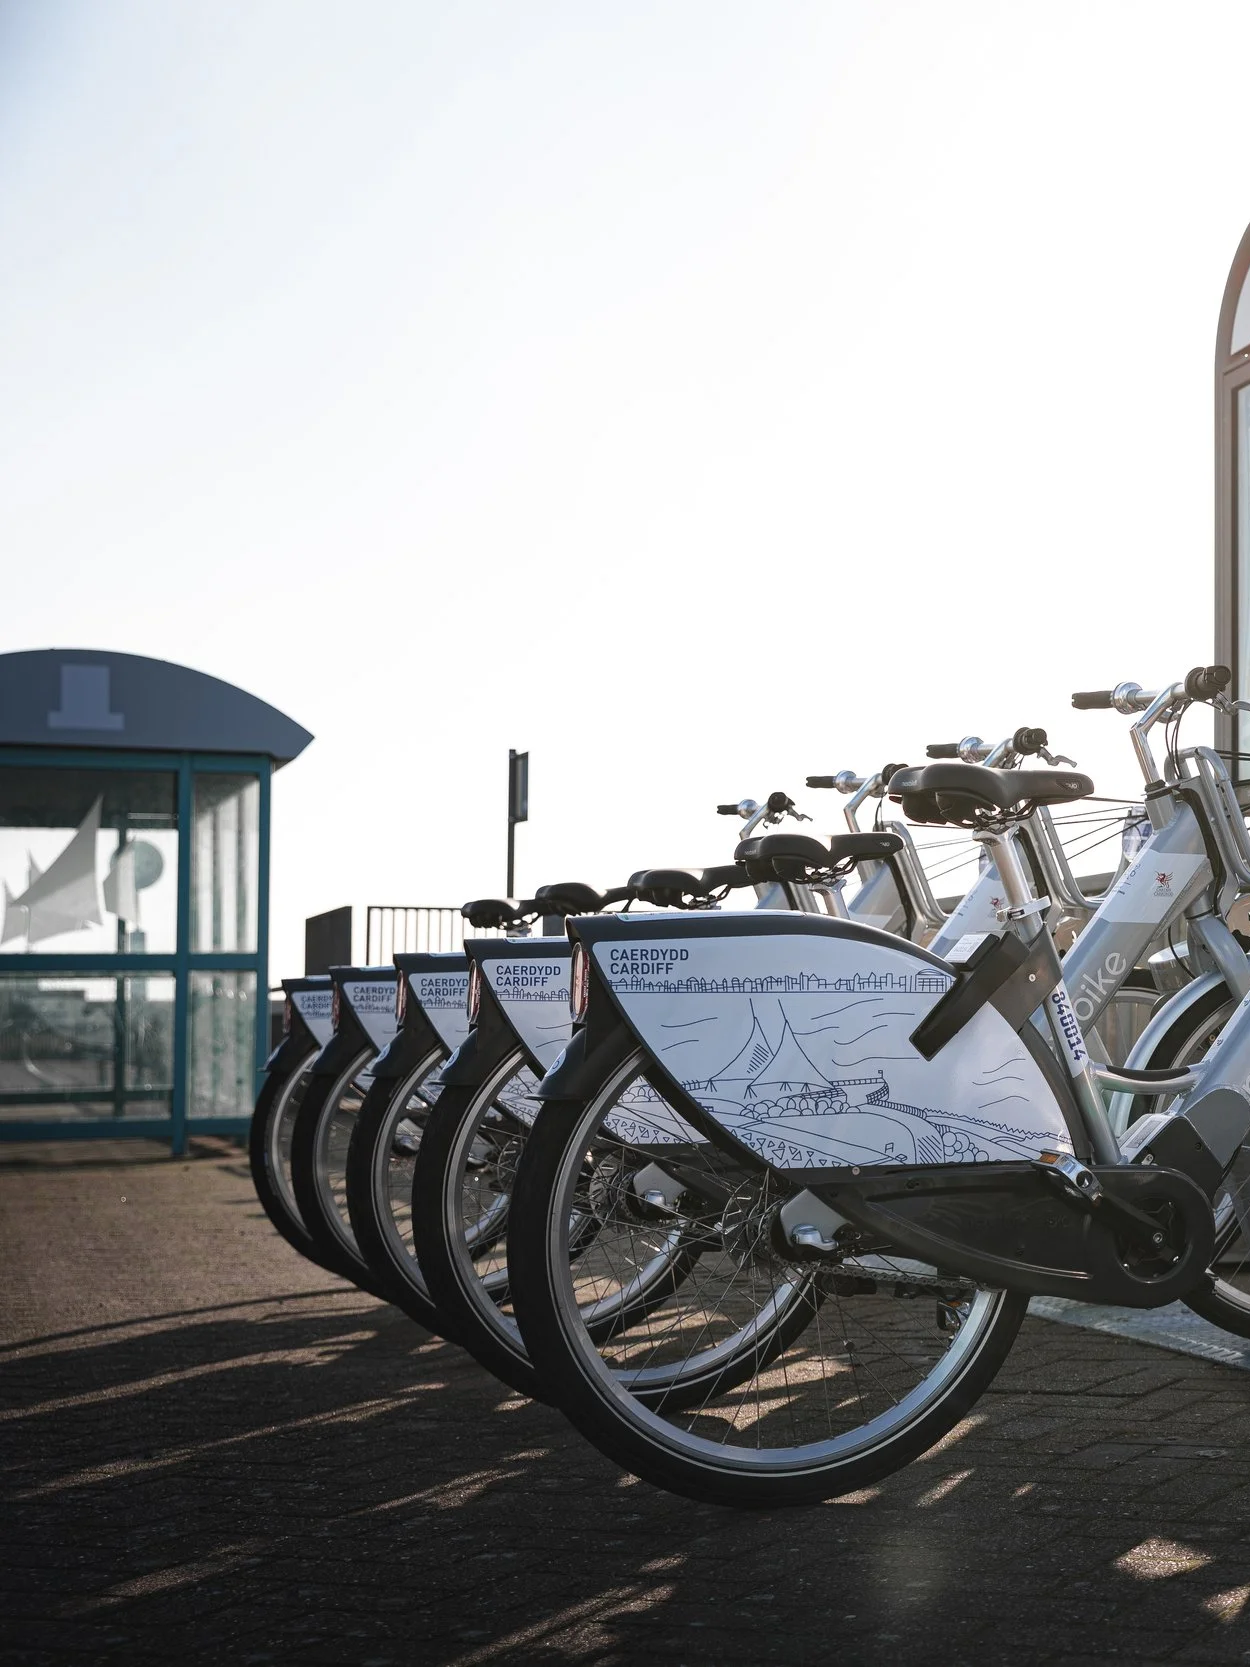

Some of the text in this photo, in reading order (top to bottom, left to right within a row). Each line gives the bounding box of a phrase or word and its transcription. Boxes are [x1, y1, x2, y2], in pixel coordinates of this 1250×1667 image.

[610, 948, 689, 961] CAERDYDD
[496, 966, 561, 976] CAERDYDD
[610, 962, 674, 975] CARDIFF
[420, 978, 468, 987] CAERDYD
[496, 976, 548, 987] CARDIFF
[354, 986, 396, 994] CAERDYD
[420, 988, 465, 997] CARDIFF
[353, 994, 392, 1003] CARDIFF
[1051, 991, 1086, 1061] 840014
